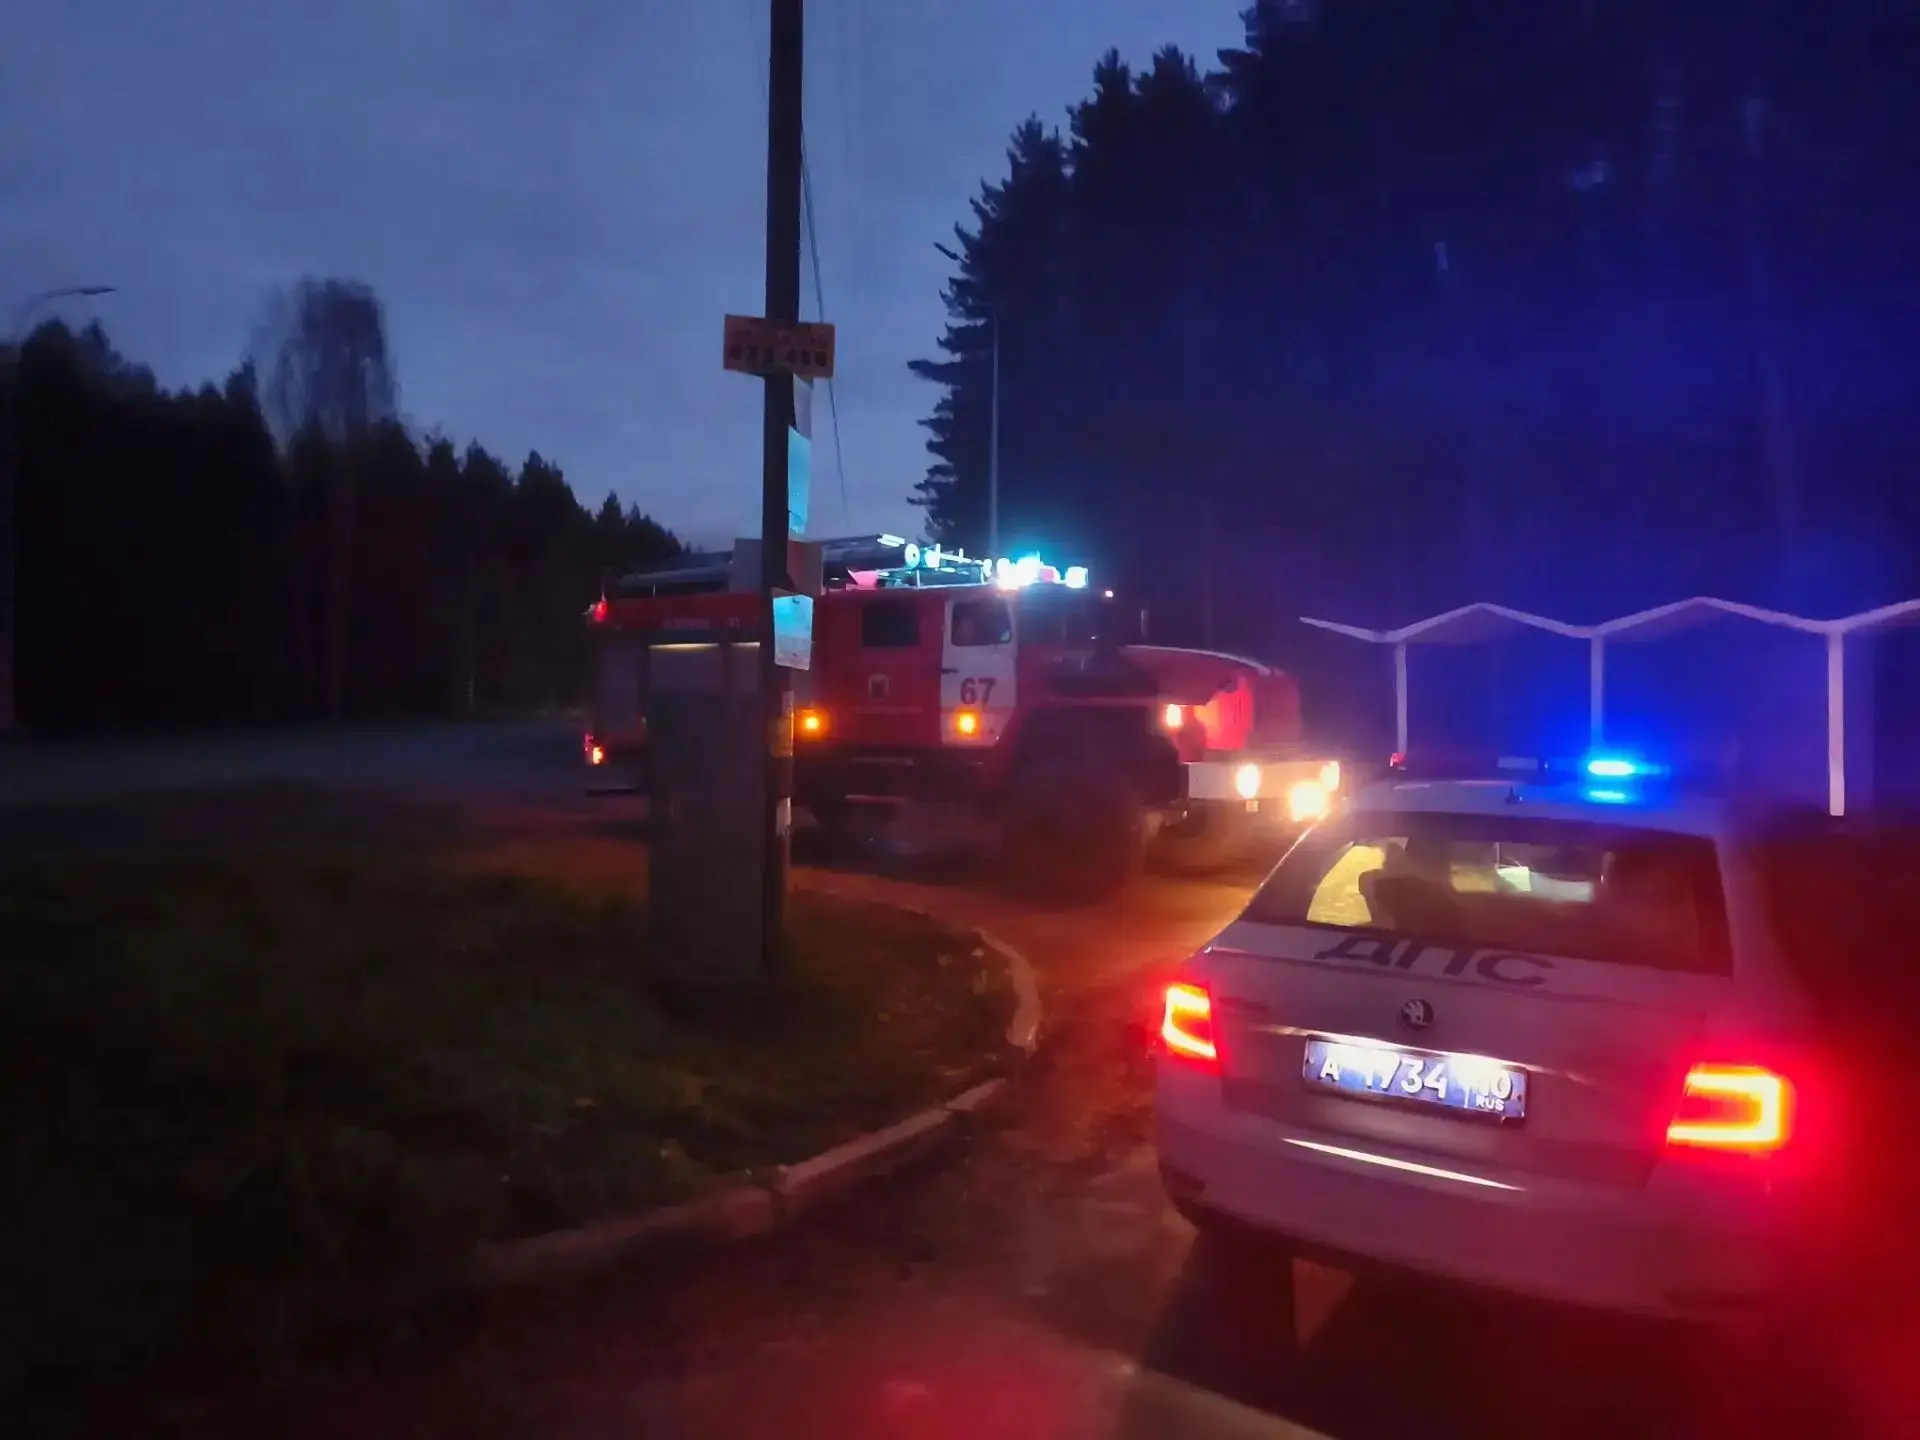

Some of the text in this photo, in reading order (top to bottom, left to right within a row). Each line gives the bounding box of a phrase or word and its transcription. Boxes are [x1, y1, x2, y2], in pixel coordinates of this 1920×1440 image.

[960, 677, 997, 711] 67
[1313, 932, 1555, 986] ДПС
[1476, 1094, 1504, 1111] RUS
